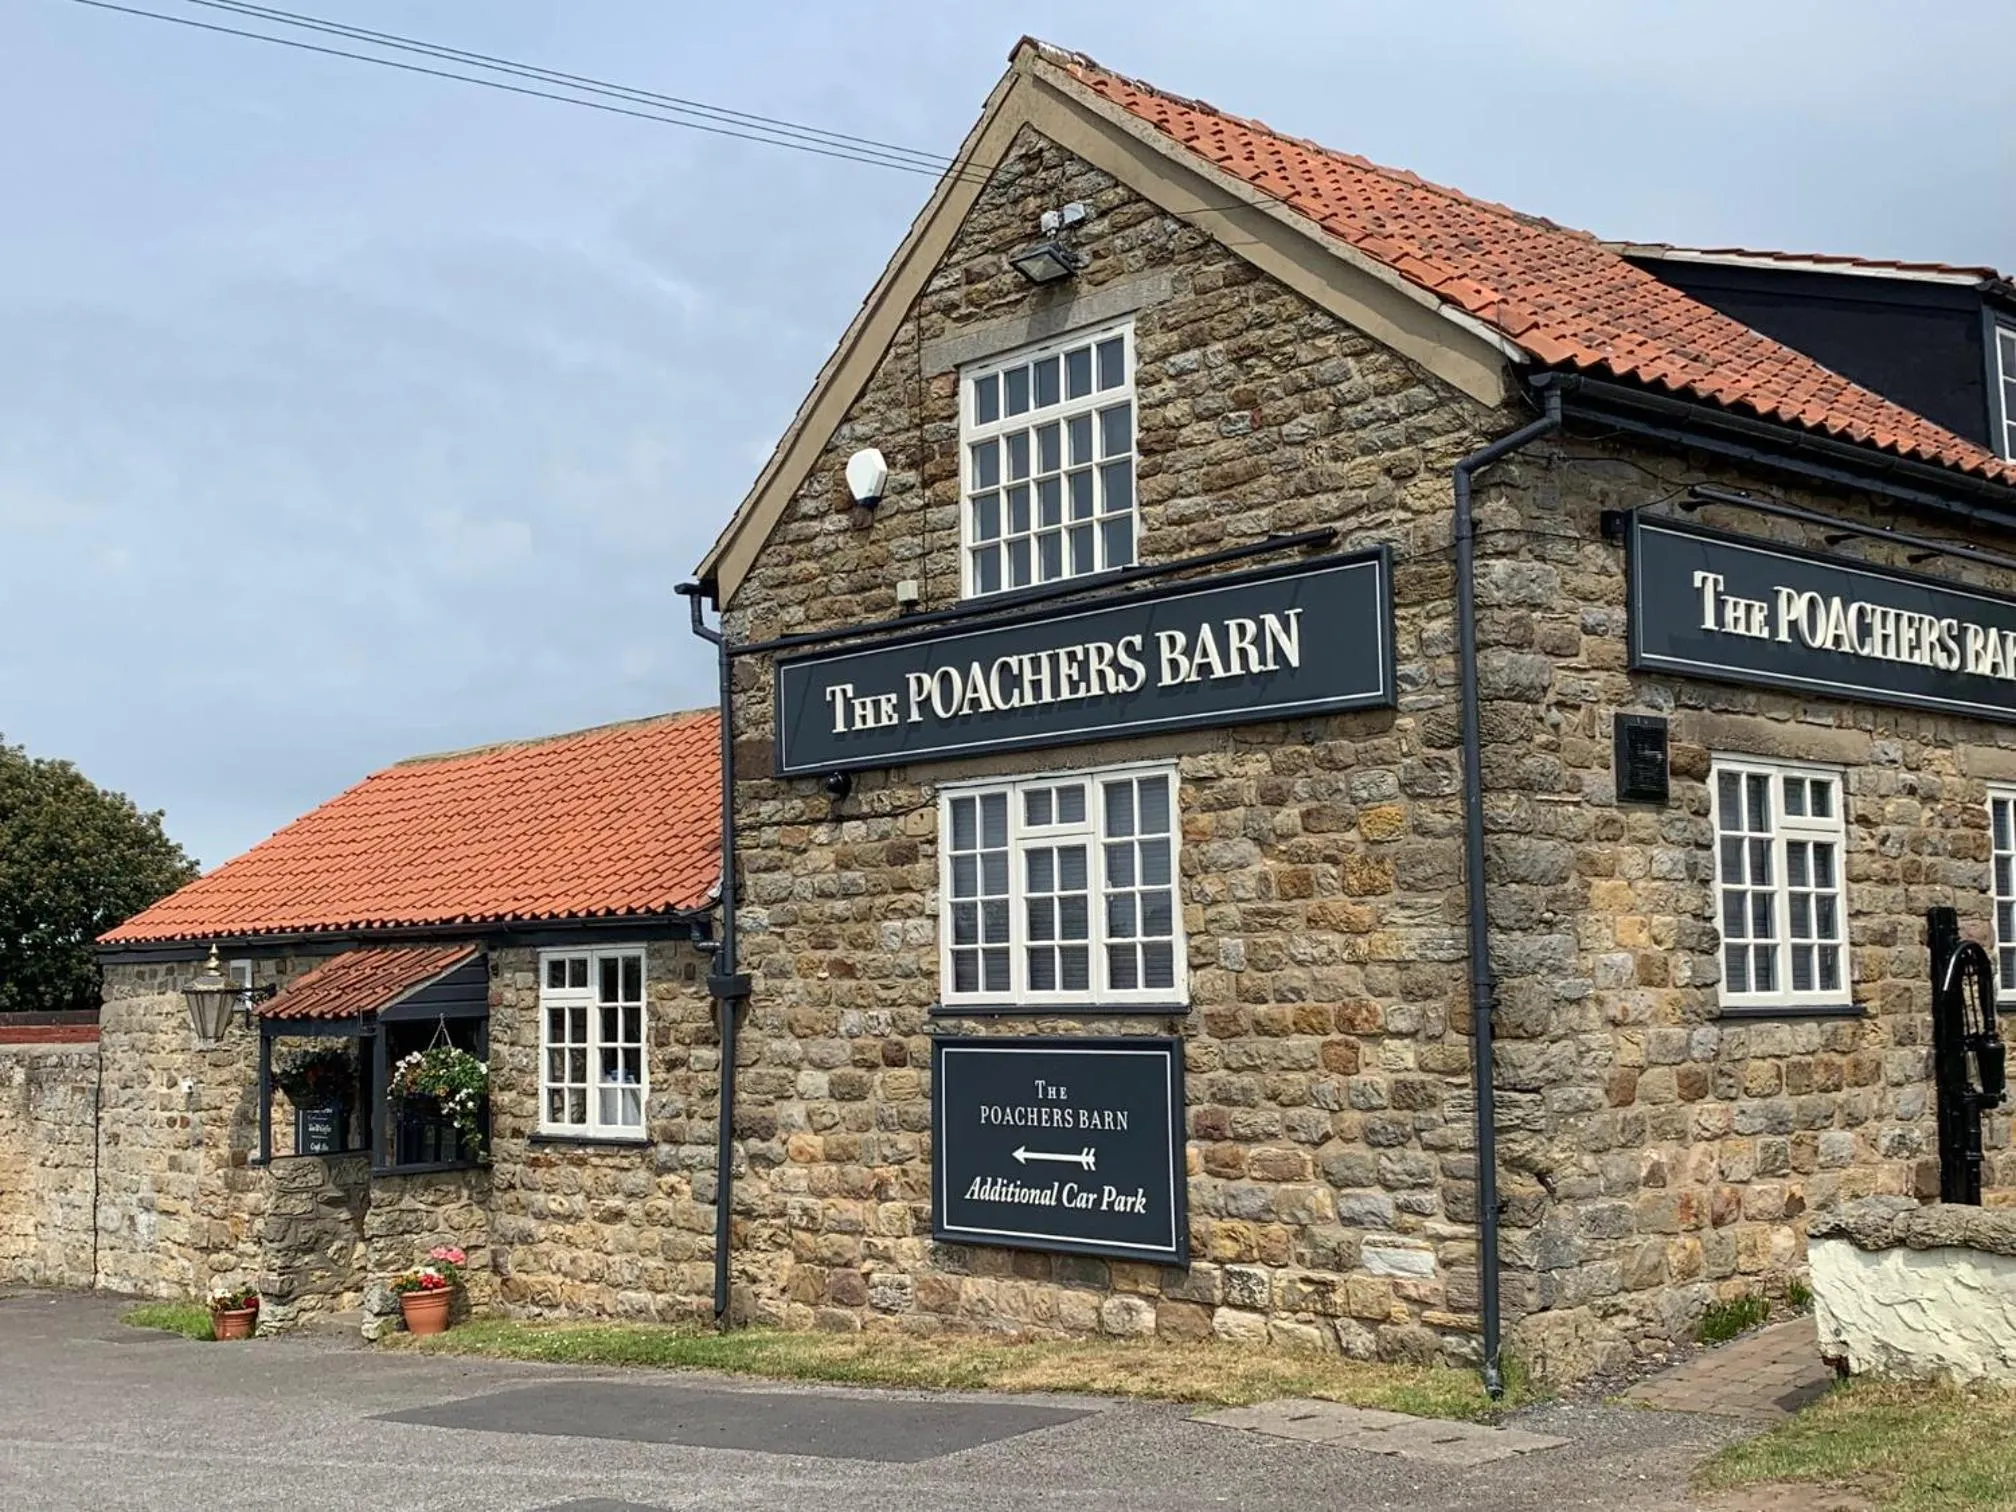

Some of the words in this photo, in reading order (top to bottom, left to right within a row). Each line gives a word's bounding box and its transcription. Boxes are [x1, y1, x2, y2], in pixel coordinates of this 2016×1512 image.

[1773, 585, 1961, 671] POACHERS
[905, 634, 1146, 724] POACHERS
[1156, 608, 1303, 687] BARN
[980, 1105, 1074, 1129] POACHERS
[1079, 1110, 1128, 1131] BARN
[965, 1176, 1059, 1206] Additional
[1062, 1183, 1097, 1210] Car
[1101, 1186, 1147, 1214] Park
